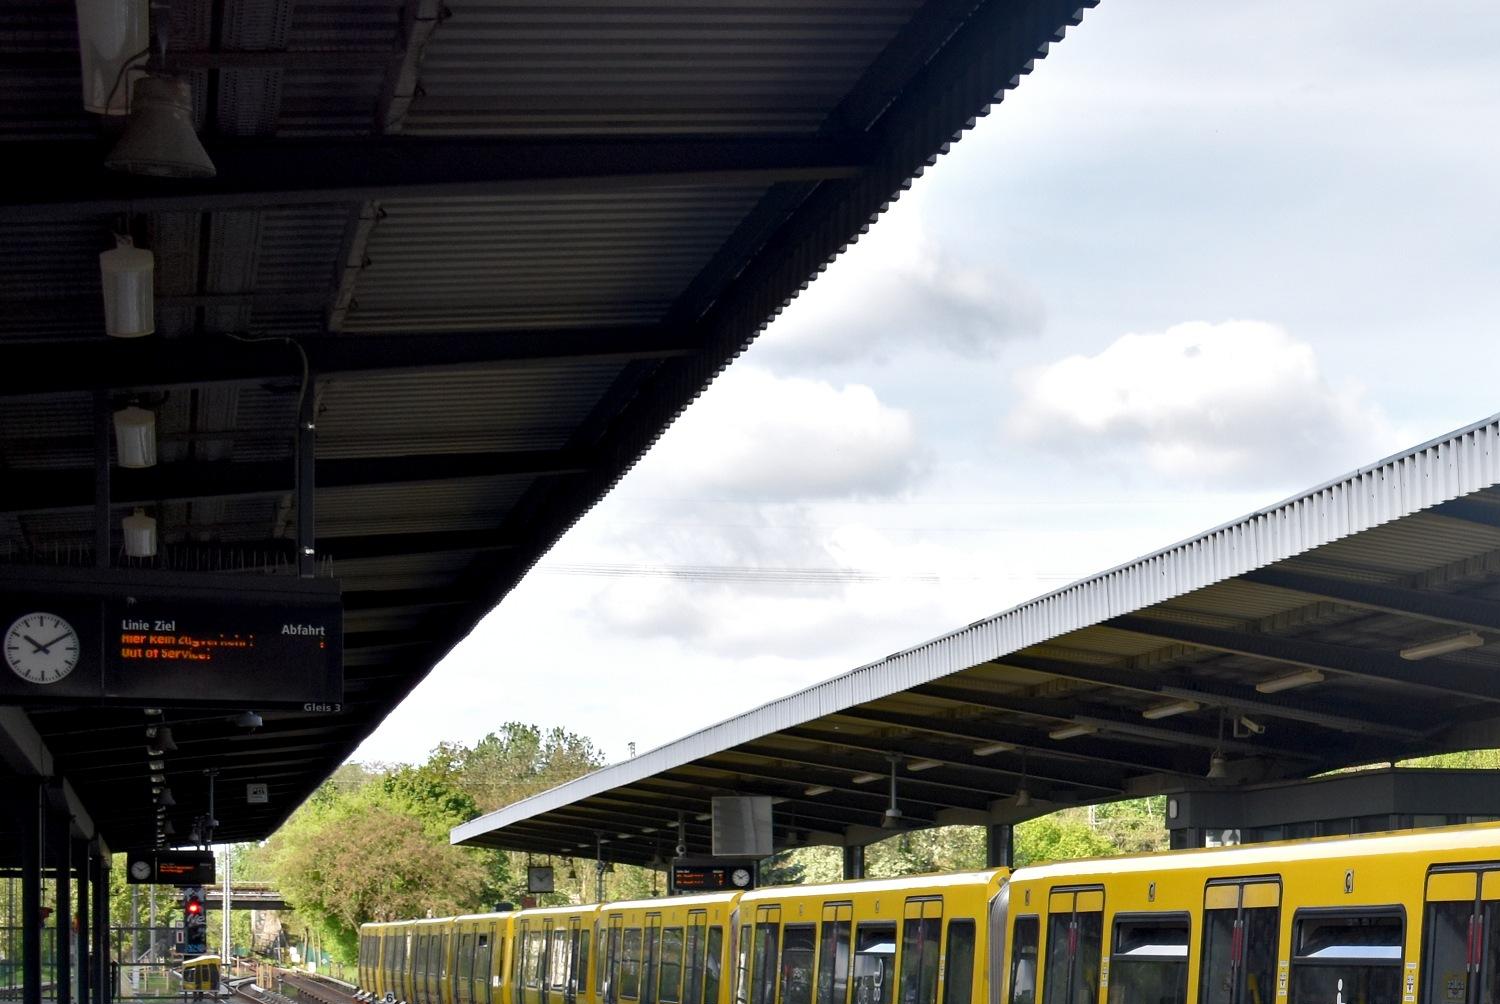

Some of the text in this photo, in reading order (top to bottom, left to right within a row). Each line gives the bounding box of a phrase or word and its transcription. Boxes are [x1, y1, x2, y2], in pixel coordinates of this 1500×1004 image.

[121, 619, 176, 632] Linie Ziel
[281, 624, 325, 636] Abfahrt
[303, 702, 341, 713] Gleis 3
[386, 993, 394, 1004] 6
